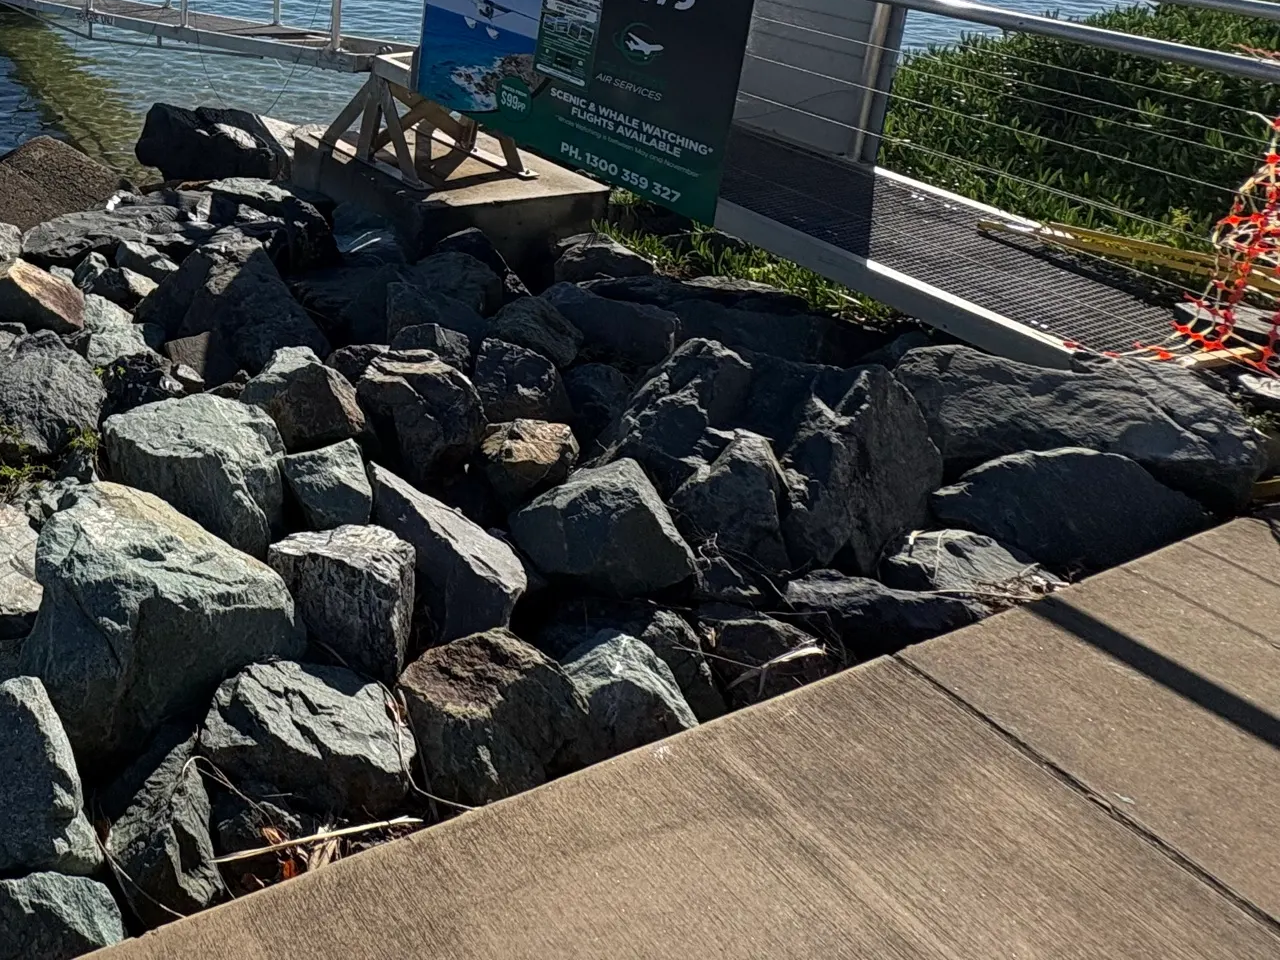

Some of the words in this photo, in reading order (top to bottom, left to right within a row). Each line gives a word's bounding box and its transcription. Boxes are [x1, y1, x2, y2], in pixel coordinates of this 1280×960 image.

[550, 87, 587, 108] SCENIC
[588, 101, 596, 113] &
[599, 104, 640, 130] WHALE
[595, 73, 614, 85] AIR
[613, 79, 663, 102] SERVICES
[571, 106, 615, 131] FLIGHTS
[616, 125, 682, 158] AVAILABLE
[560, 141, 582, 161] PH.
[585, 151, 619, 177] 1300
[621, 167, 649, 190] 359
[651, 181, 681, 203] 327
